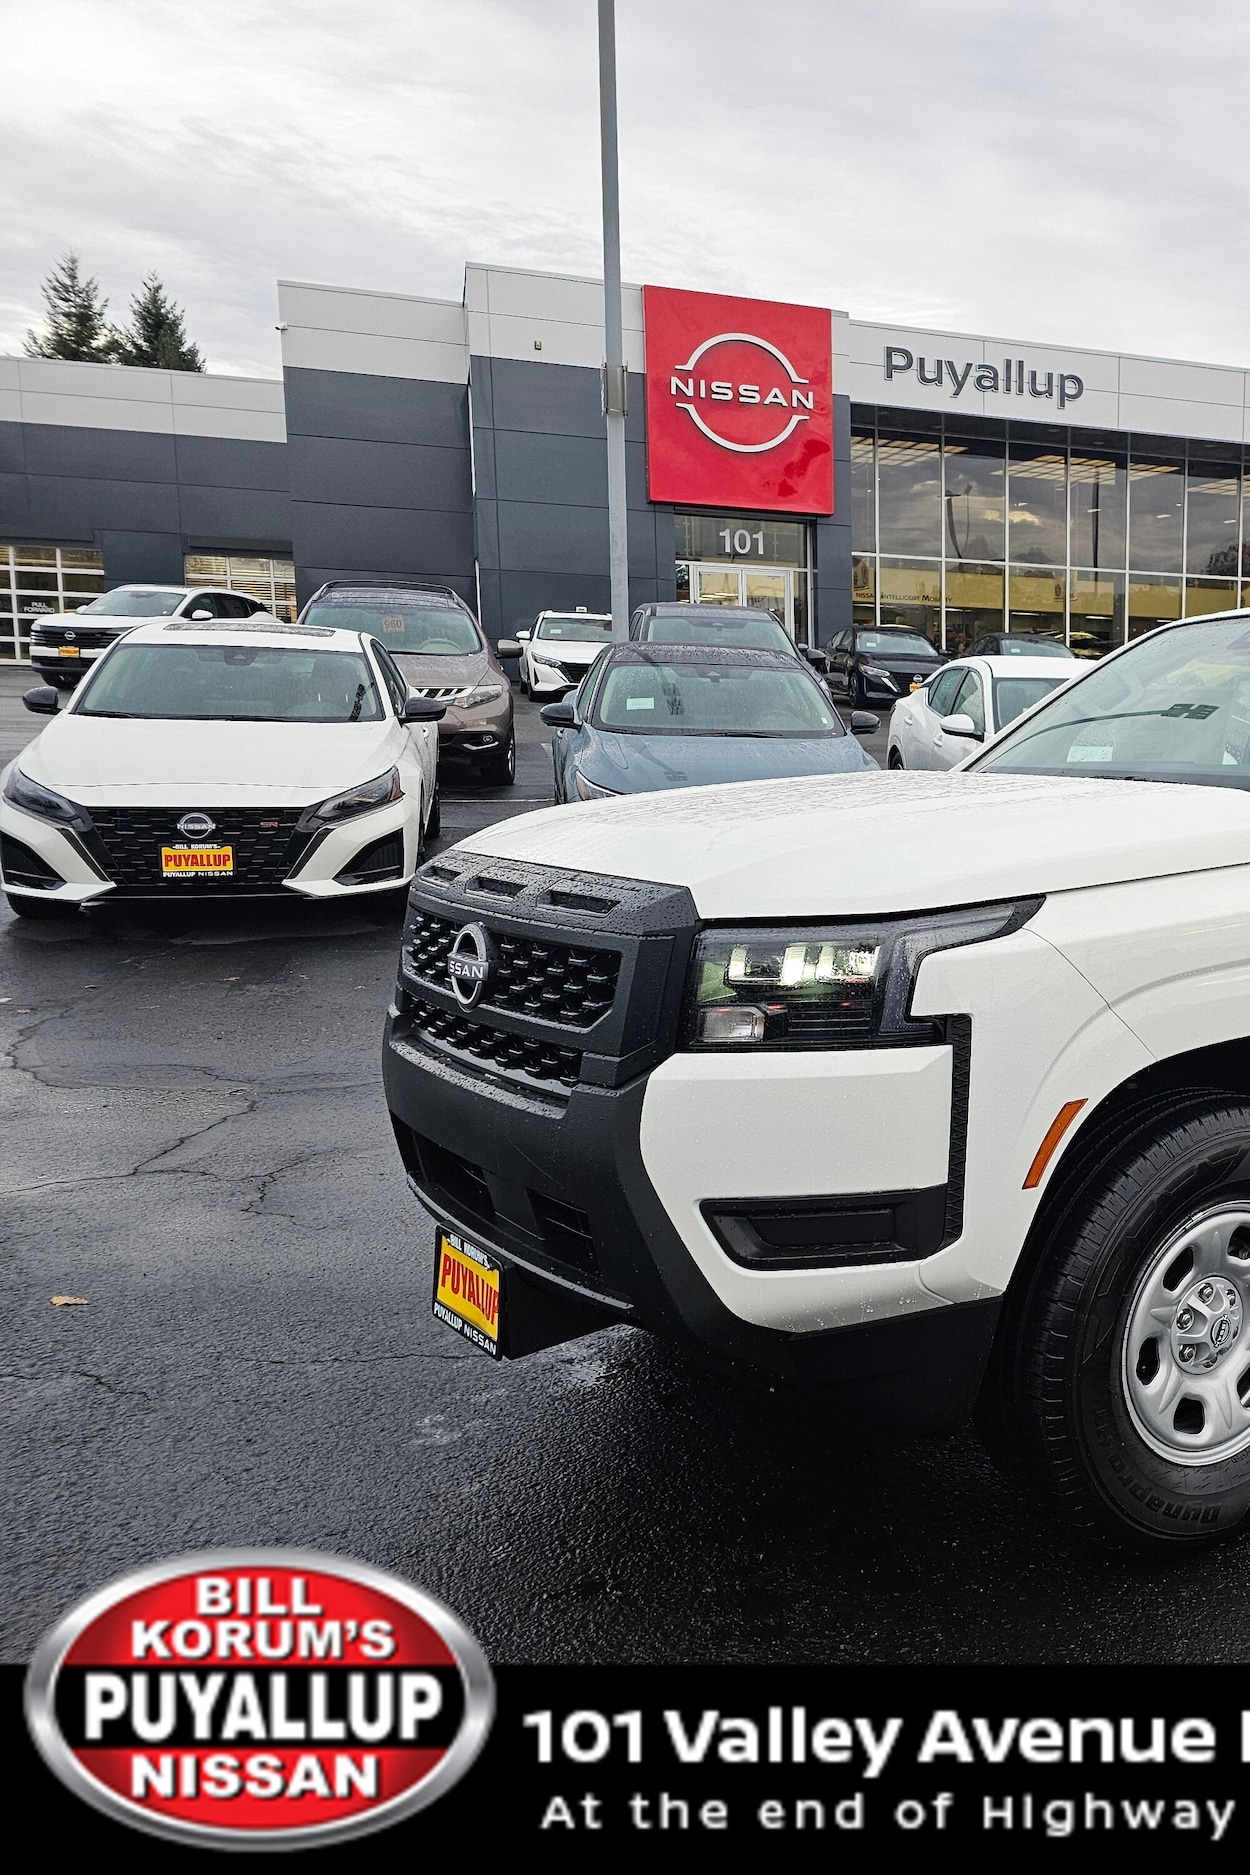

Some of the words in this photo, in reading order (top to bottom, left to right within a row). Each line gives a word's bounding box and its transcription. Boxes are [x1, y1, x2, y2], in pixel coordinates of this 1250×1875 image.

[670, 376, 815, 411] NISSAN
[884, 346, 1085, 409] Puyallup
[718, 528, 766, 556] 101
[163, 854, 231, 868] PUYALLUP
[450, 1233, 462, 1252] BILL
[441, 1253, 500, 1326] PUYALLUP
[433, 1302, 463, 1332] PUYALLUP
[463, 1324, 497, 1356] NISSAN
